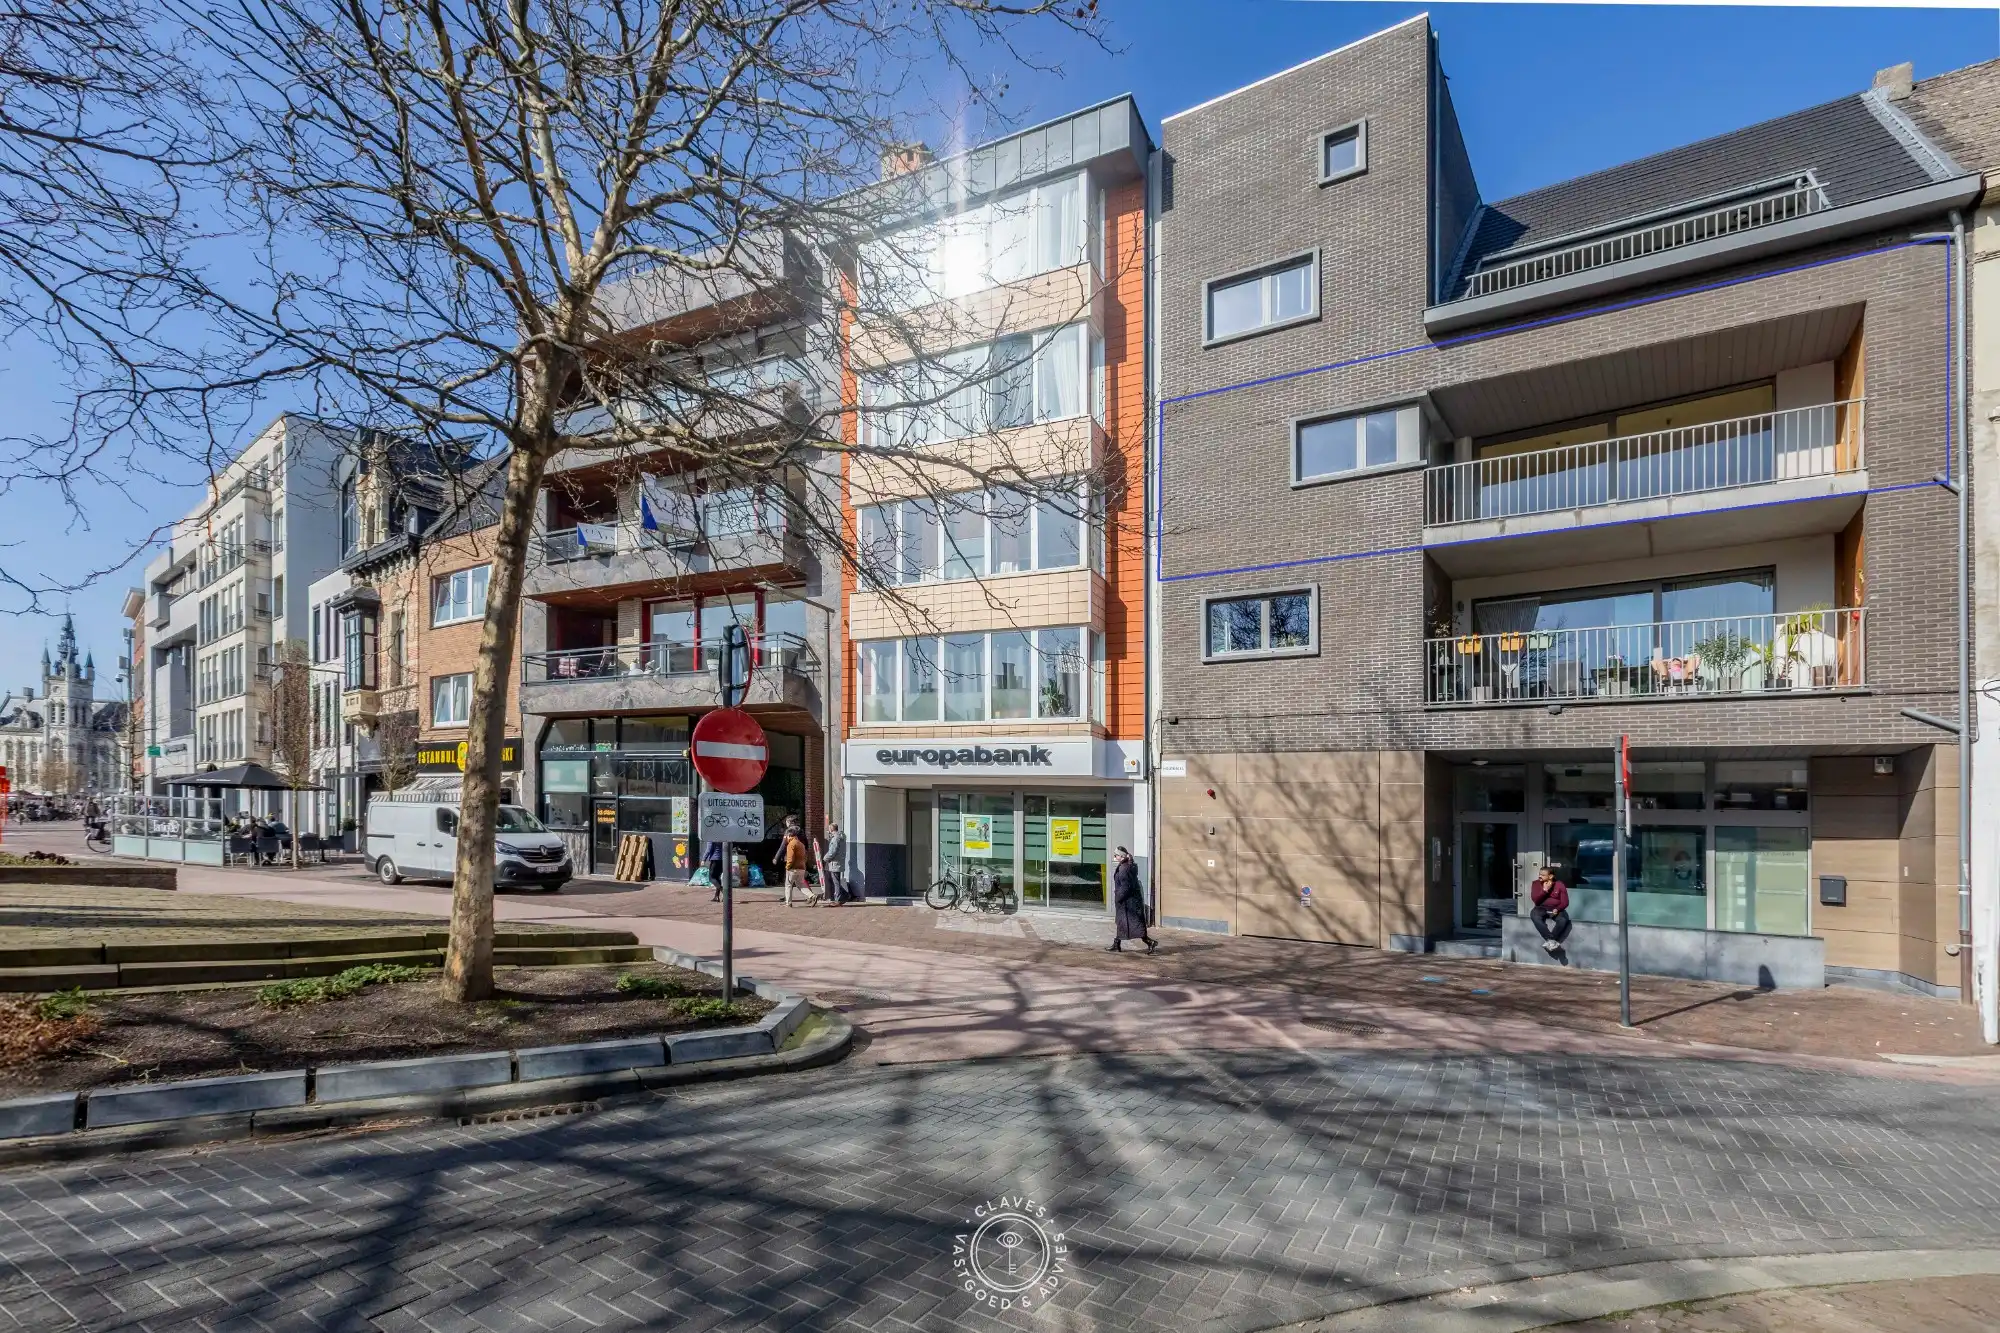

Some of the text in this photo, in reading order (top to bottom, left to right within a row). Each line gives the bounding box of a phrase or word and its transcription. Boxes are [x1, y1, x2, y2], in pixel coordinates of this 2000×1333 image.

[418, 750, 456, 764] ISTANBUL
[876, 745, 1051, 769] europabank
[707, 798, 757, 808] UITGEZONDERD
